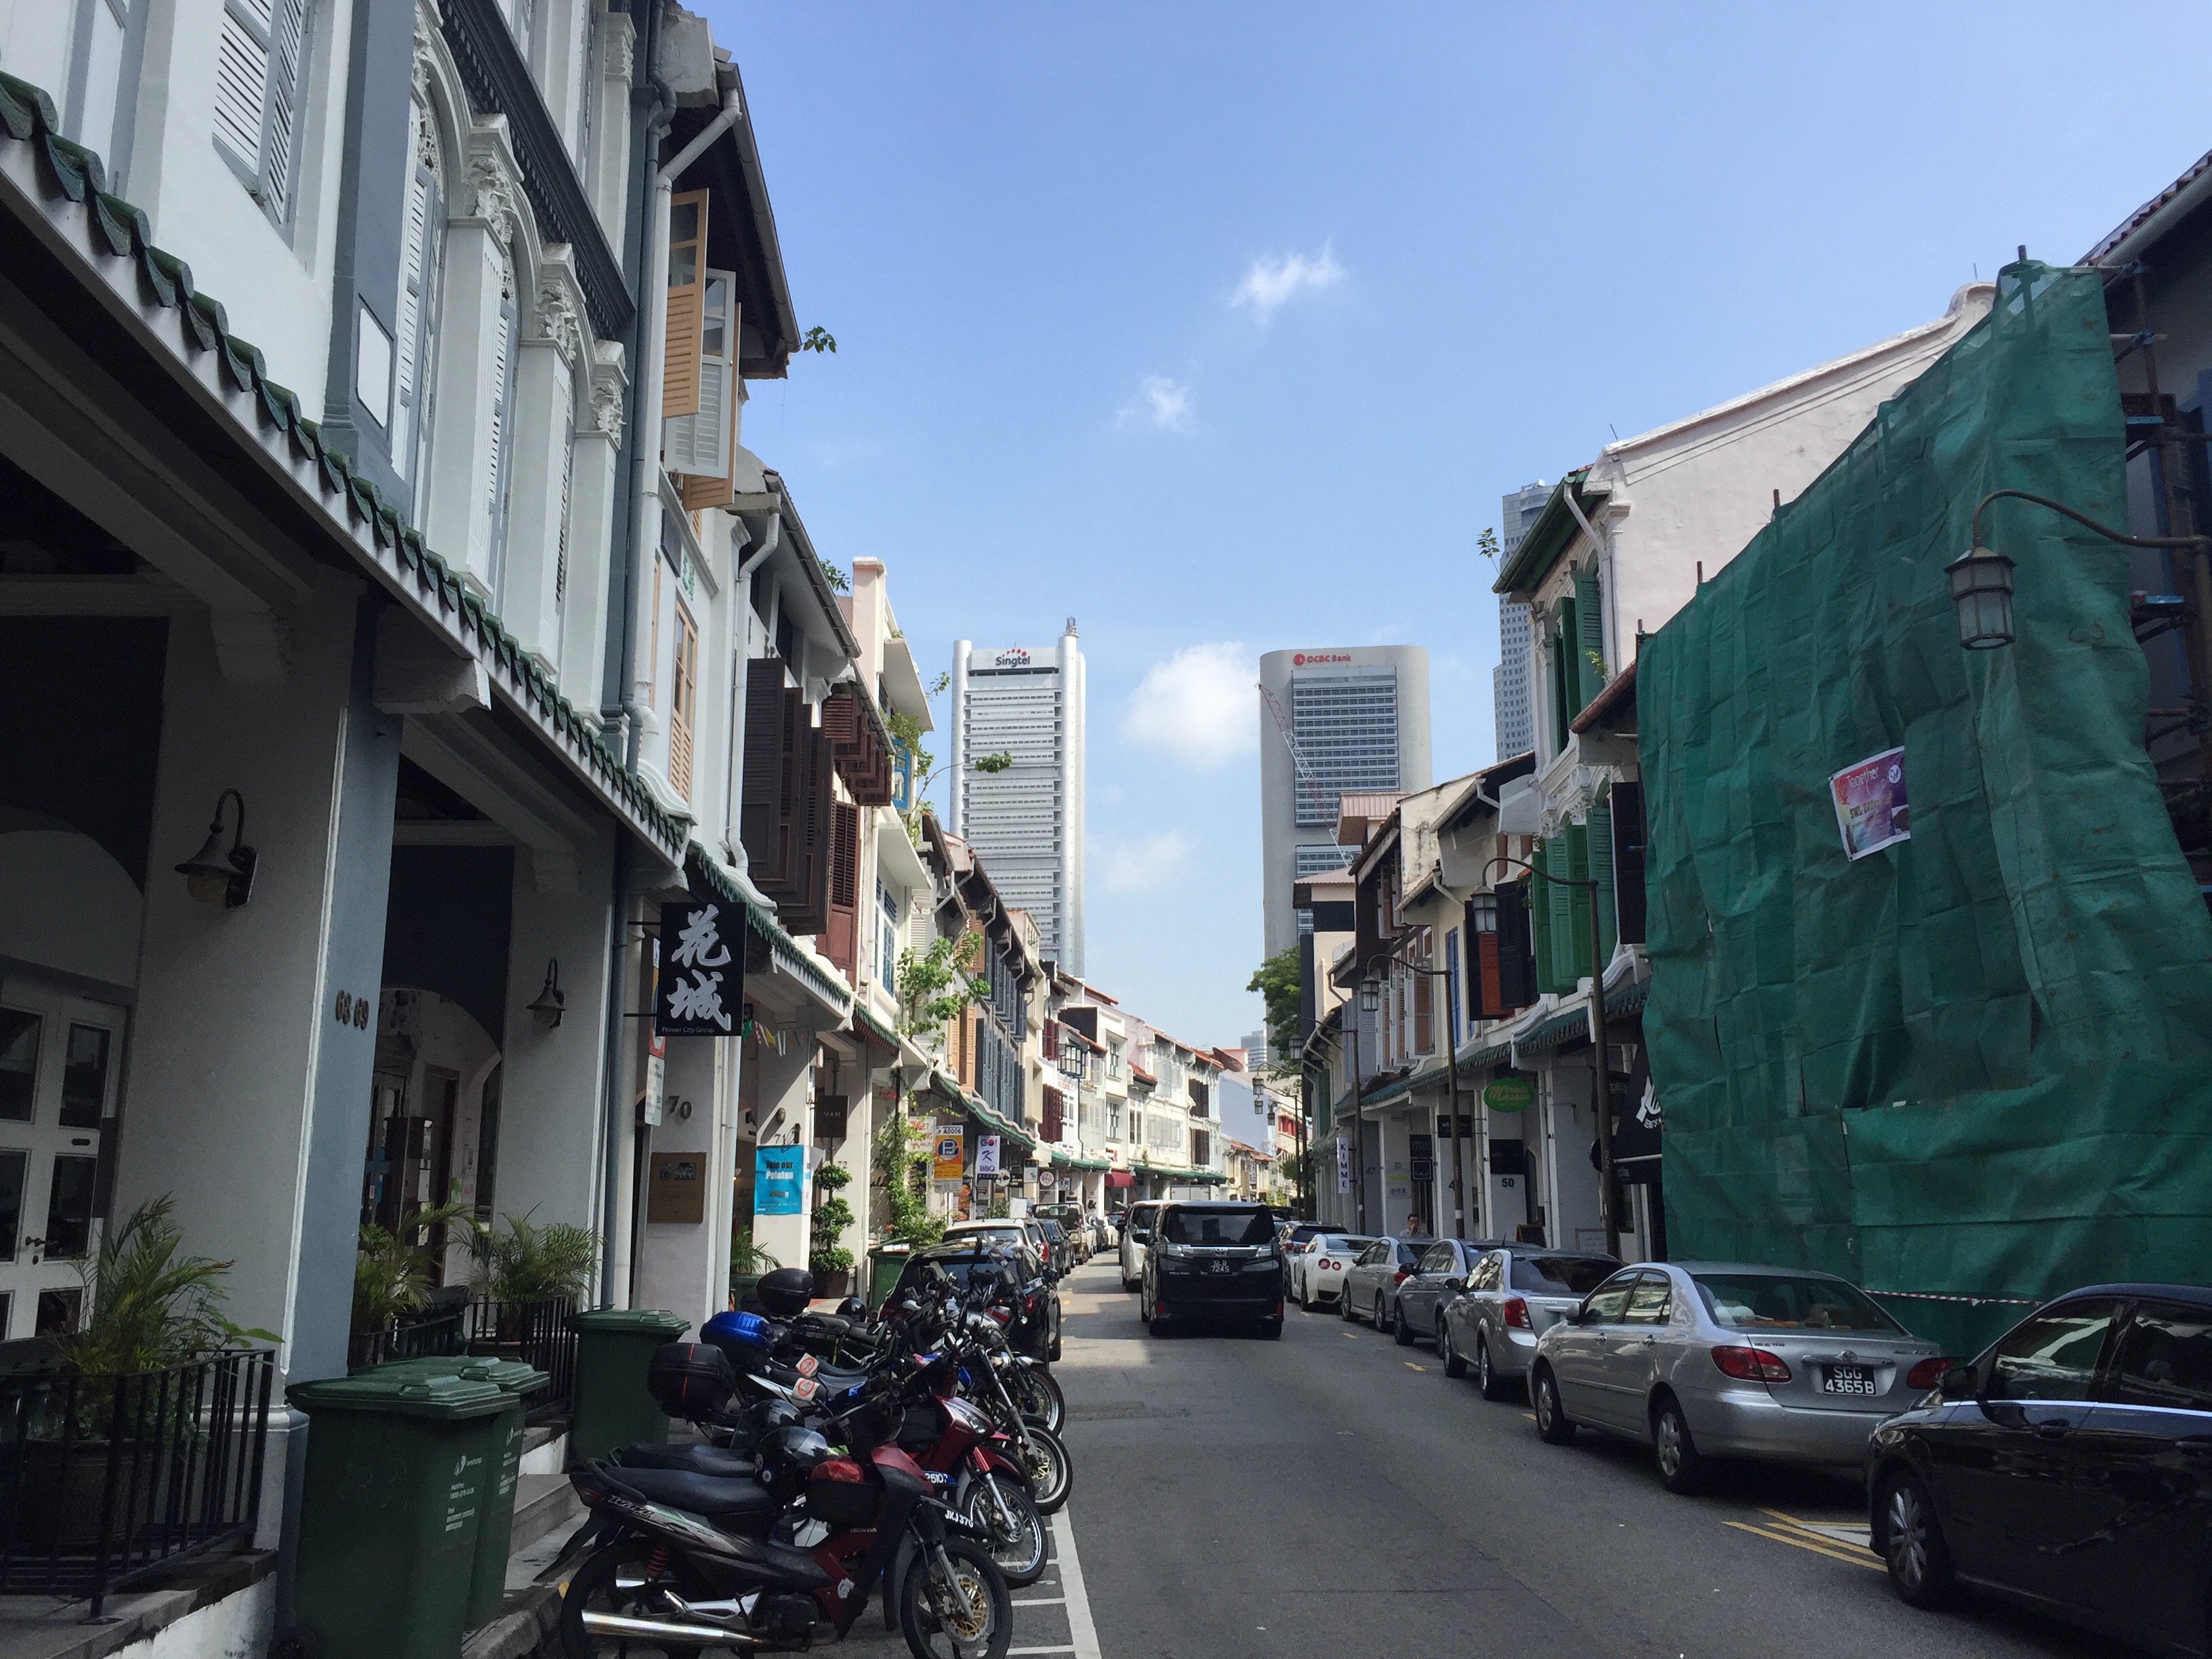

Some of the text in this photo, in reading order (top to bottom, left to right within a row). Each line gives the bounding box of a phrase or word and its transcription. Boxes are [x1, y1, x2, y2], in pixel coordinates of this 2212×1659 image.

[996, 655, 1031, 668] Singtel
[1846, 766, 1879, 794] Together
[666, 903, 732, 1031] 花城
[682, 1026, 695, 1034] City
[668, 1095, 693, 1120] 70
[980, 1139, 997, 1147] GO!
[982, 1150, 994, 1162] K
[766, 1160, 780, 1169] Join
[836, 1160, 848, 1170] 72
[1340, 1143, 1348, 1188] KIMME
[766, 1170, 794, 1180] Peloton
[1501, 1178, 1515, 1188] 50
[1834, 1366, 1862, 1378] SGG
[1824, 1380, 1875, 1395] 4365B
[945, 1509, 959, 1523] JKJ
